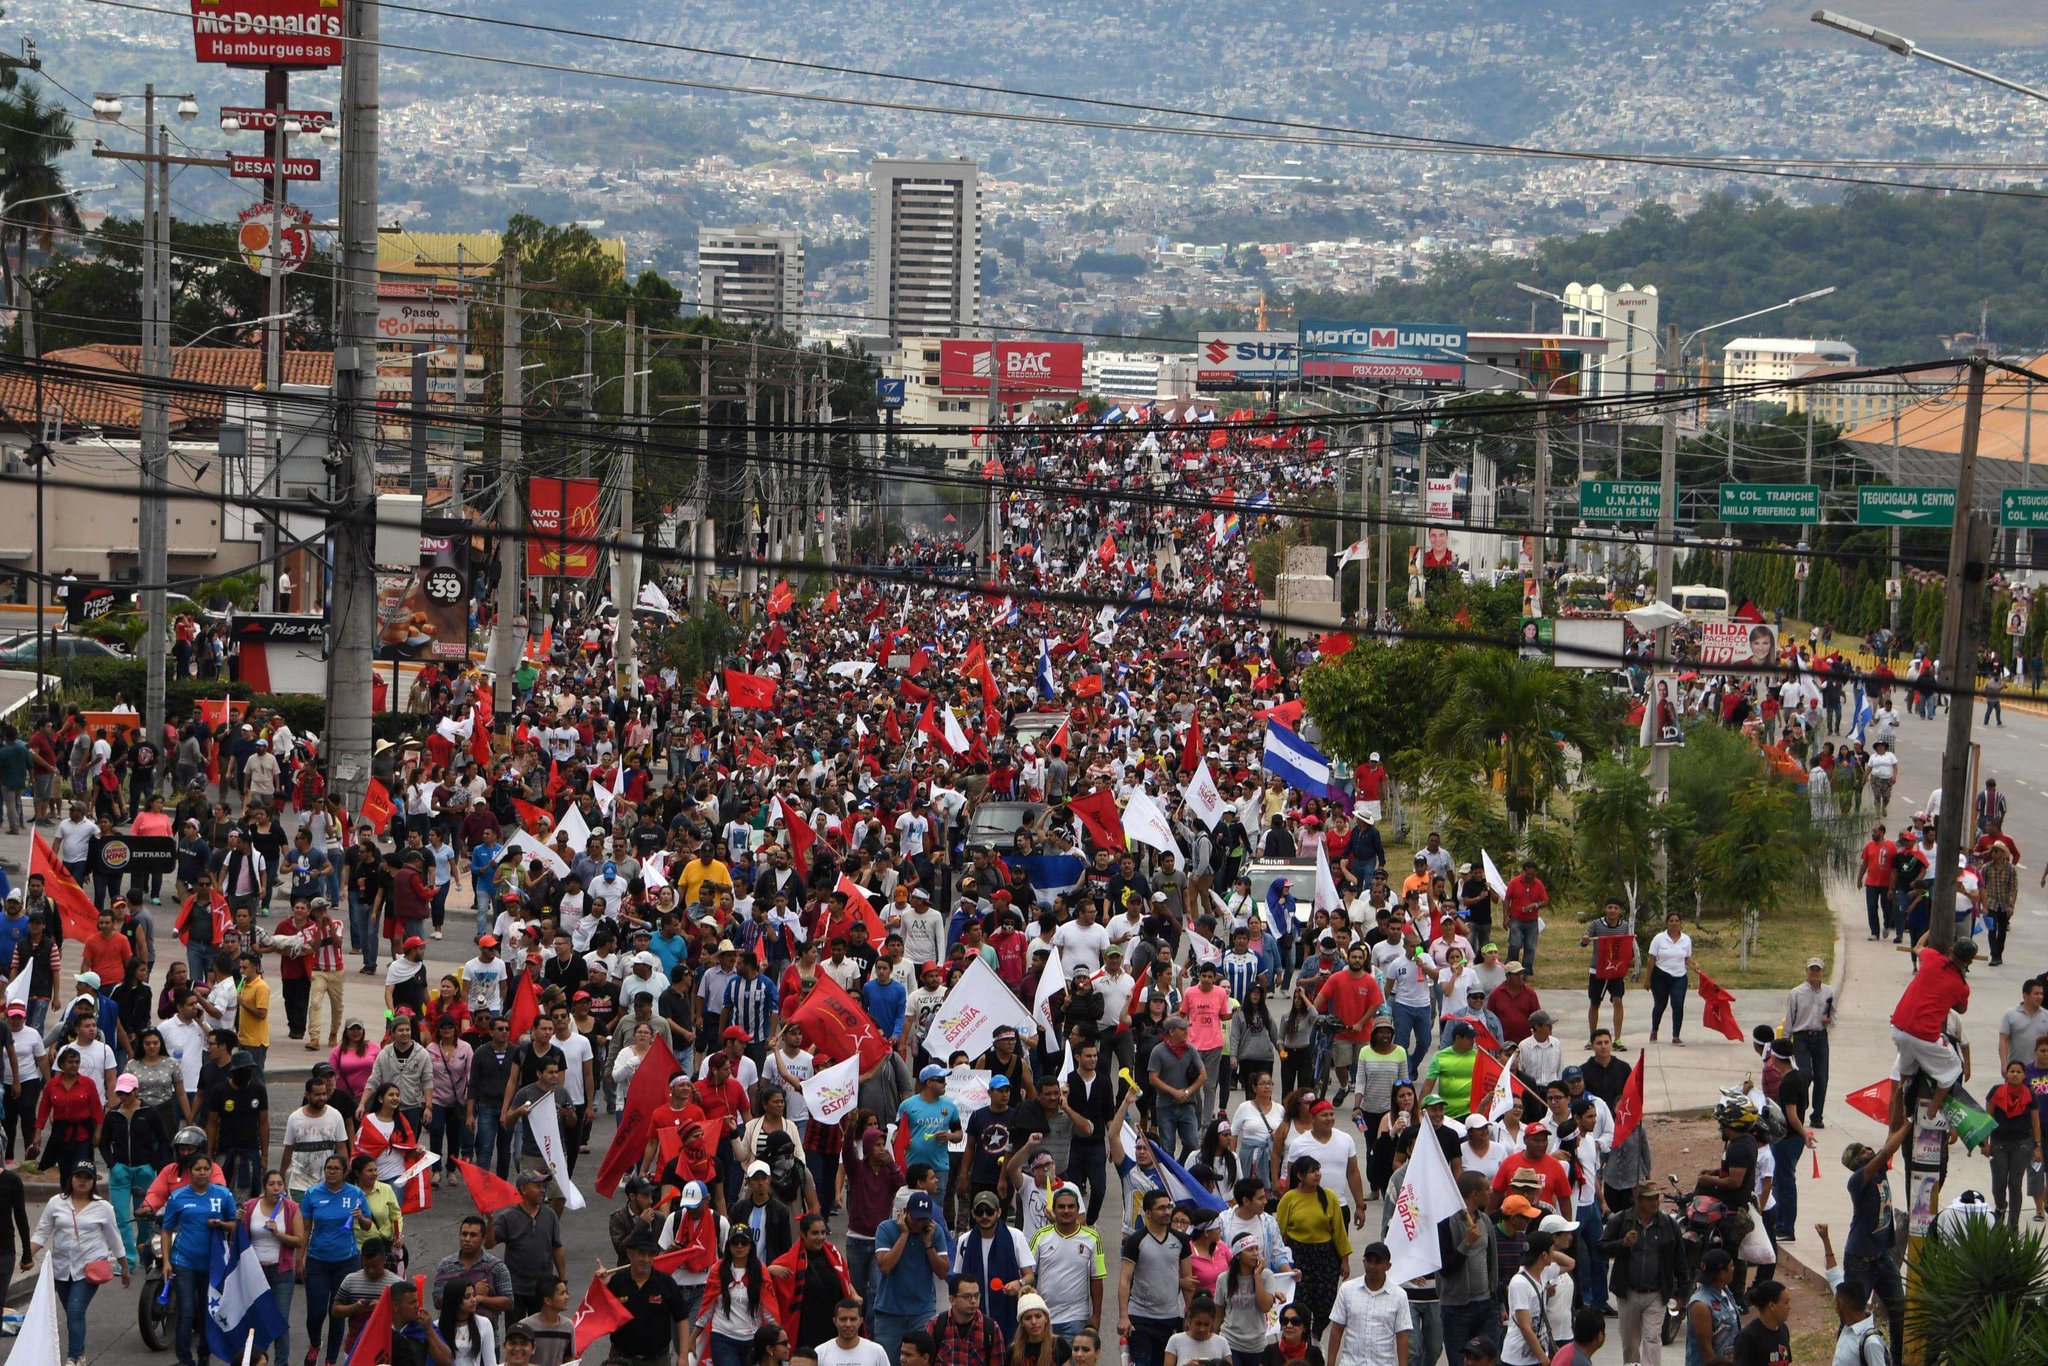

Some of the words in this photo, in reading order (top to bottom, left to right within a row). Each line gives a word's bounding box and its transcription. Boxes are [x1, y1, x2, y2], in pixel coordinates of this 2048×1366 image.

[197, 11, 341, 36] McDonald's
[212, 40, 332, 58] Hamburguesas
[226, 111, 277, 127] UTO
[1616, 298, 1647, 307] Marriott
[401, 306, 440, 318] Paseo
[1006, 351, 1051, 372] BAC
[1006, 371, 1051, 379] CREDOMATIC
[1352, 365, 1372, 375] PBX
[1373, 366, 1423, 376] 2202-7006
[1605, 496, 1653, 506] U.N.A.H.
[1739, 491, 1762, 501] COL.
[1766, 491, 1814, 502] TRAPICHE
[1862, 492, 1918, 506] TEGUCIGALPA
[1921, 493, 1955, 507] CENTRO
[531, 509, 560, 518] AUTO
[1582, 507, 1624, 517] BASILICA
[1625, 508, 1638, 517] DE
[1722, 506, 1750, 516] ANILLO
[1752, 507, 1797, 517] PERIFERICO
[1800, 507, 1816, 518] SUR
[2007, 511, 2029, 521] COL.
[532, 520, 558, 528] MAC
[83, 593, 115, 615] Pizza
[270, 622, 305, 636] Pizza
[1703, 623, 1748, 636] HILDA
[1702, 635, 1748, 644] PACHECO
[1703, 647, 1733, 664] 119
[105, 852, 127, 860] KING
[685, 1189, 695, 1198] H
[210, 1198, 222, 1213] H
[342, 1197, 351, 1208] H
